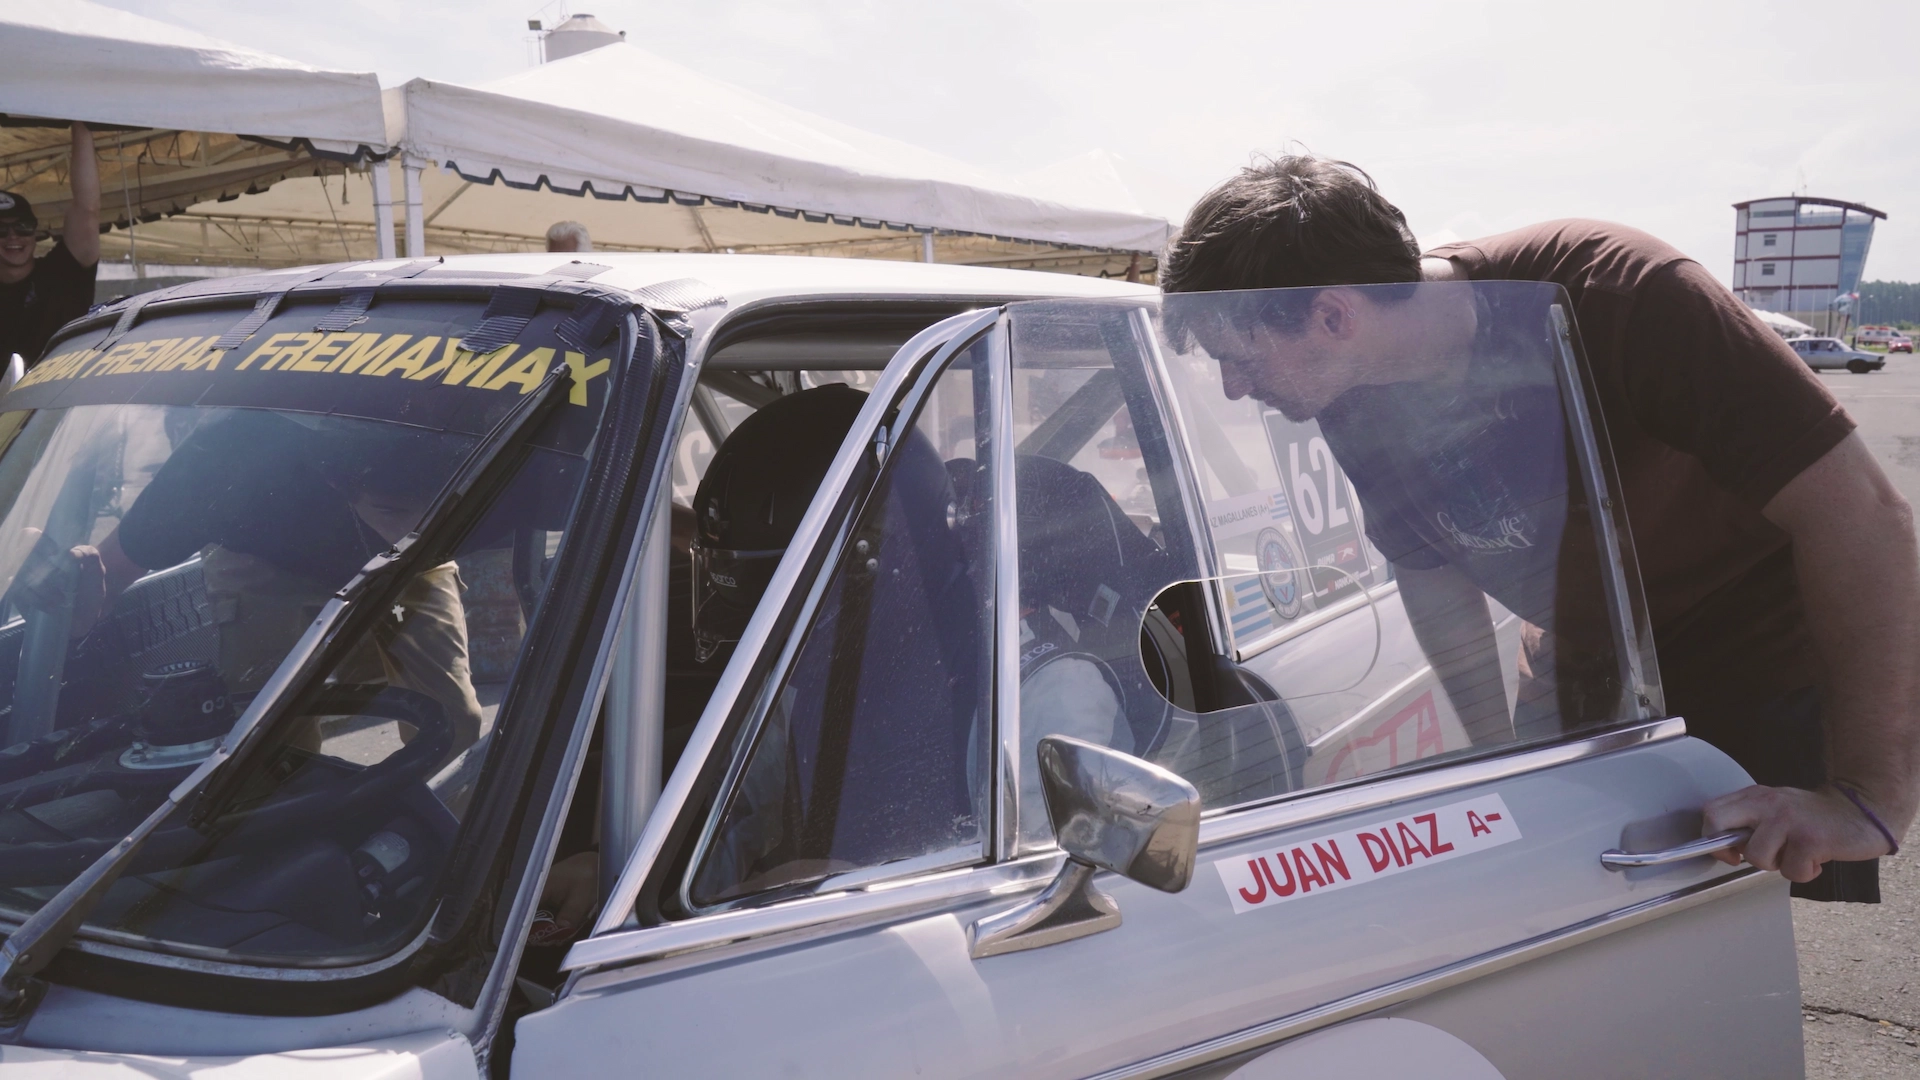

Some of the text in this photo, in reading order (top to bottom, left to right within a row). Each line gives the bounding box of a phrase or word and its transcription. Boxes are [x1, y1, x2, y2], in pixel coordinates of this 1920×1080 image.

[1218, 505, 1258, 526] MAGALLANES
[1289, 436, 1350, 535] 62
[1238, 810, 1502, 904] JUAN DIAZ A-
